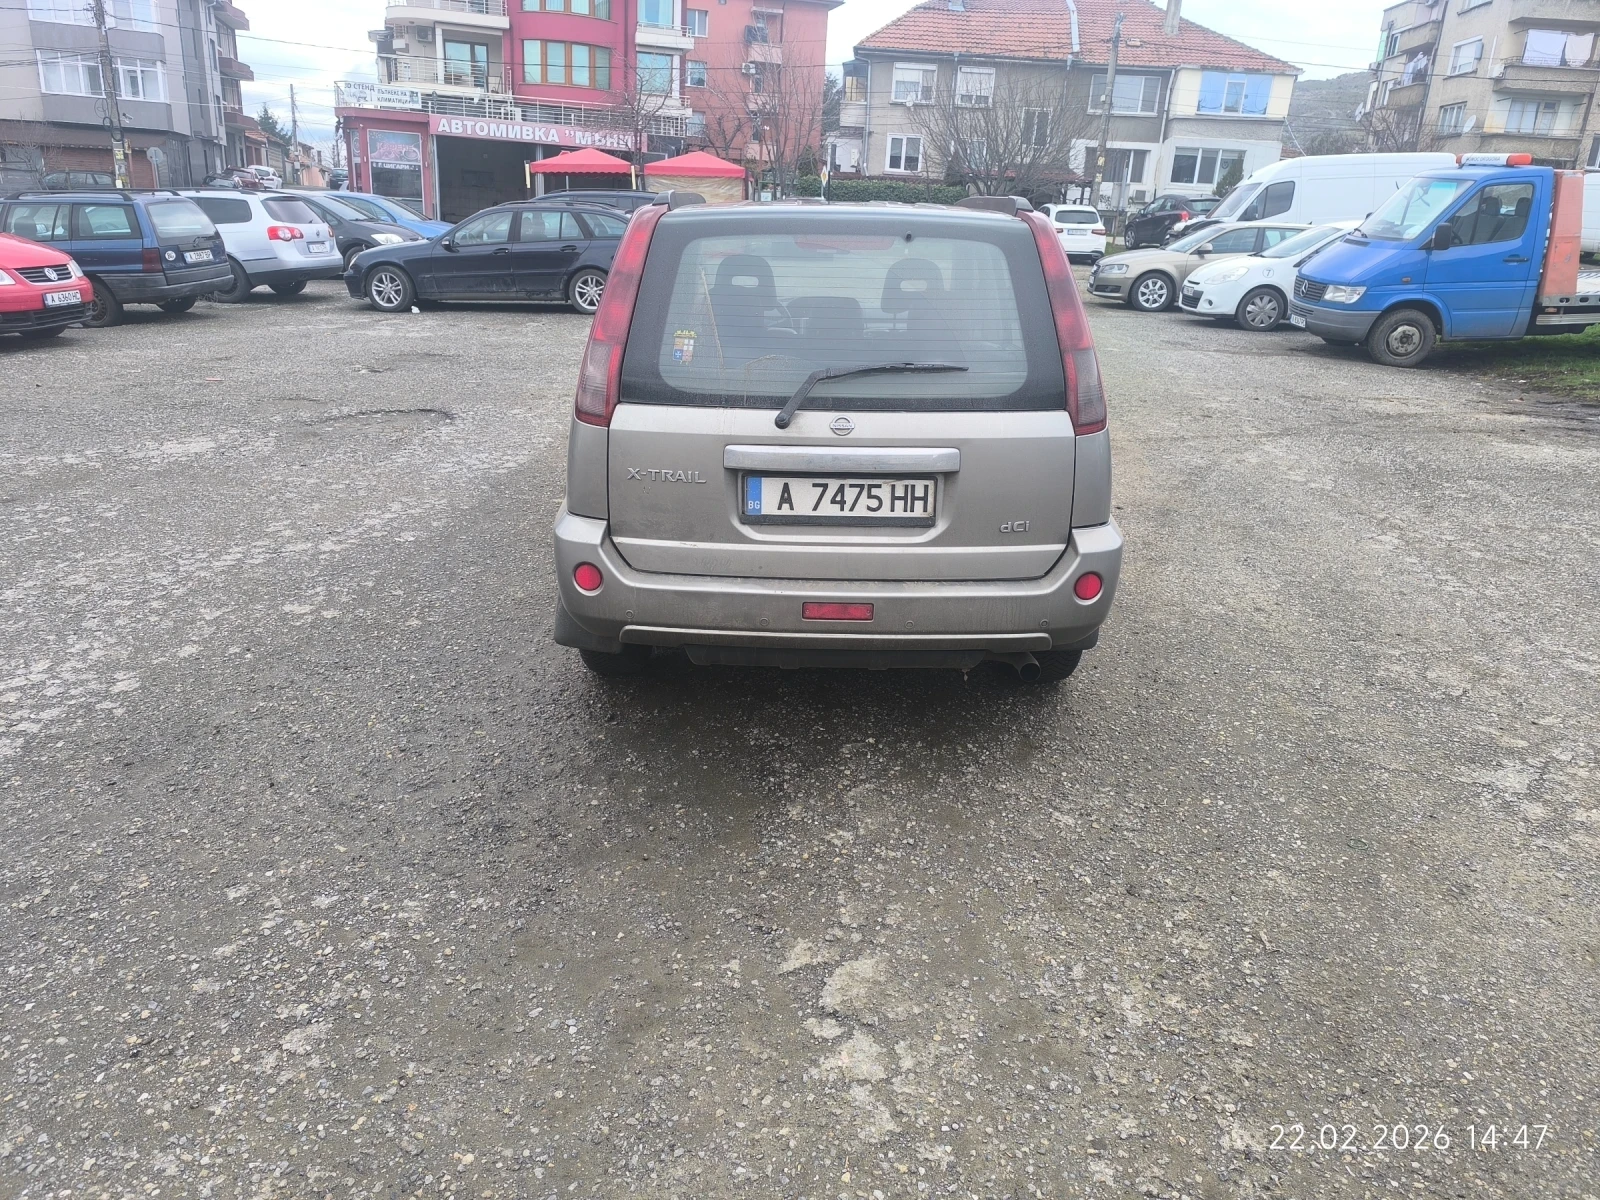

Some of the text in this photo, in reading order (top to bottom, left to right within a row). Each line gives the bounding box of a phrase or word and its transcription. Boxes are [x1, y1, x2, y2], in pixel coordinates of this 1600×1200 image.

[353, 84, 376, 92] СТЕНД
[437, 118, 560, 143] АВТОМИВКА
[1266, 269, 1272, 277] 7
[627, 467, 707, 484] X-TRAIL
[777, 482, 930, 513] A 7475 HH
[748, 501, 760, 510] BG
